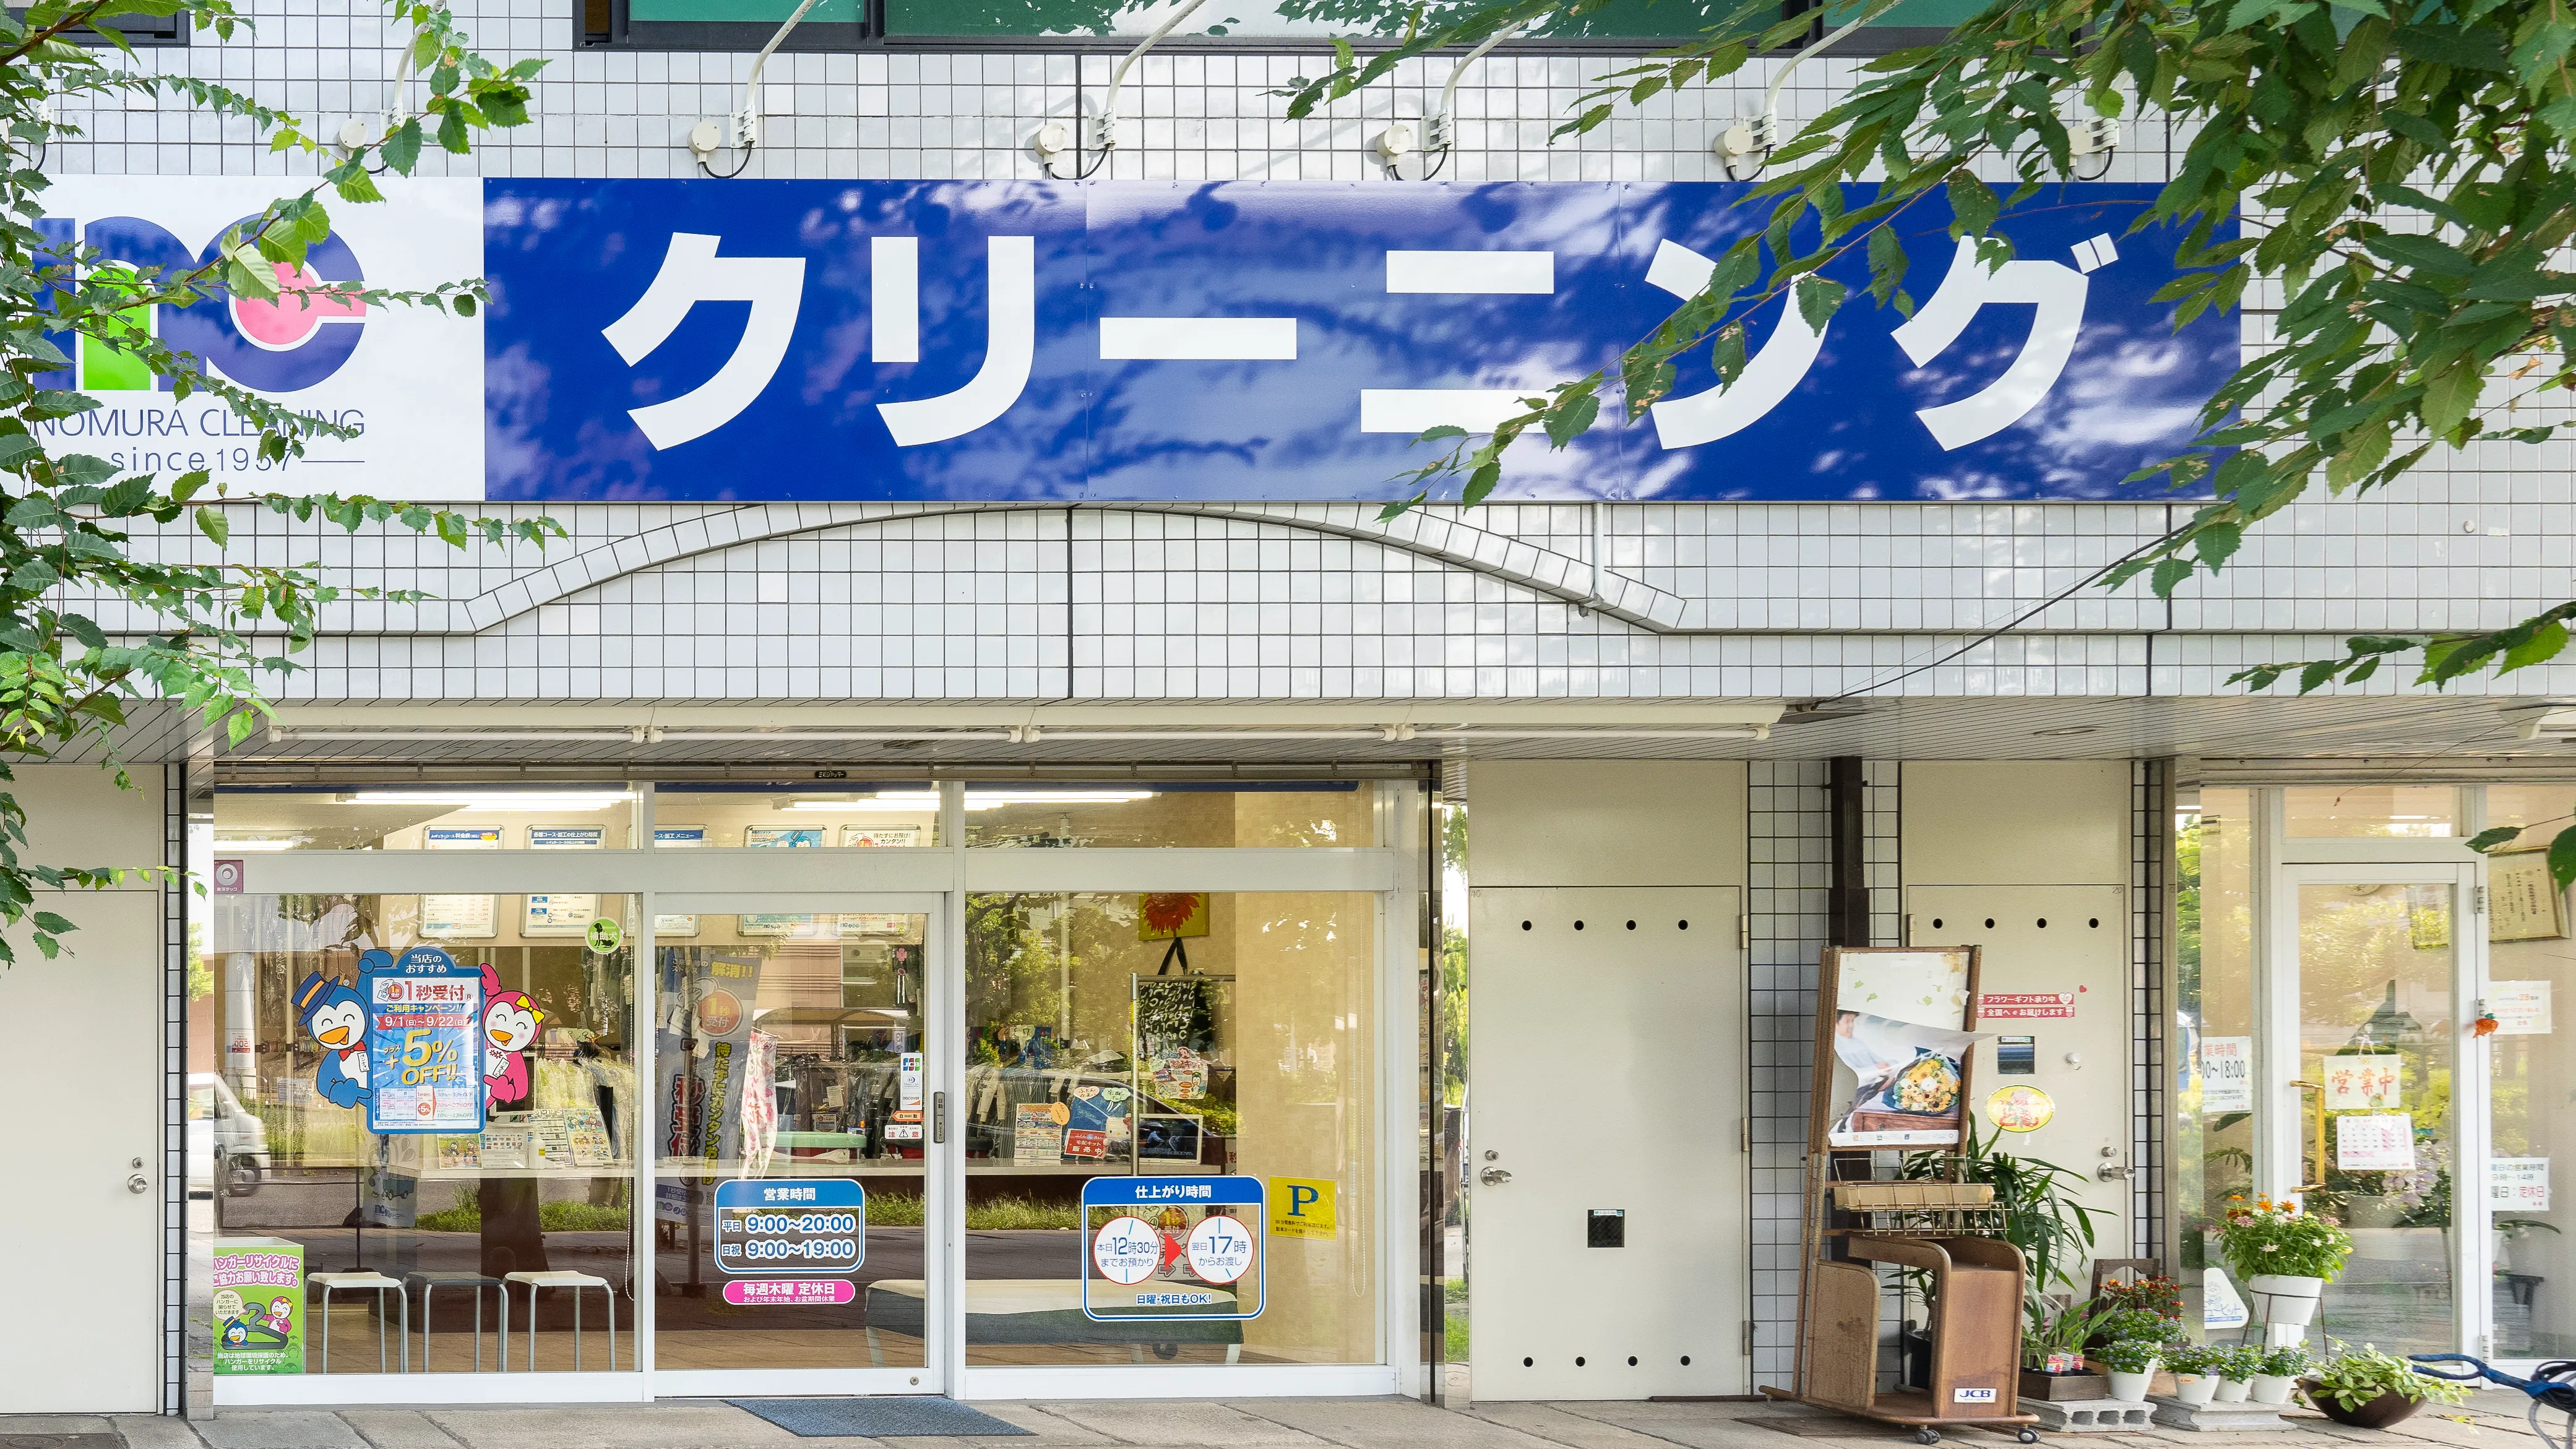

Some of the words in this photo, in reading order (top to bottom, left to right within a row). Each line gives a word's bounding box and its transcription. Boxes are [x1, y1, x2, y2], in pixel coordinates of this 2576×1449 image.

[601, 233, 2118, 451] クリーニング
[33, 409, 189, 436] NOMURA
[200, 409, 364, 436] CLEANING
[111, 447, 205, 471] since
[590, 931, 618, 940] 補助犬
[410, 954, 442, 963] 当店の
[405, 964, 447, 974] おすすめ
[711, 961, 754, 978] 解消!!
[1987, 995, 2056, 1004] フラワーギフト承り中
[386, 1004, 462, 1013] ご利用キャンペーン!!
[1987, 1008, 2011, 1017] 全国へ
[2018, 1008, 2064, 1017] お届けします
[707, 1016, 730, 1028] 受付
[903, 1060, 920, 1068] JCB
[2331, 1067, 2396, 1096] 営業中
[764, 1187, 816, 1202] 営業時間
[1135, 1185, 1212, 1199] 仕上がり時間
[1287, 1185, 1319, 1217] P
[722, 1220, 742, 1232] 平日
[722, 1244, 742, 1256] 日祝
[1097, 1237, 1159, 1255] 本日12時30分
[1192, 1236, 1247, 1254] 翌日17時
[1101, 1257, 1154, 1267] までお預かり
[1198, 1257, 1243, 1266] からお渡し
[213, 1272, 298, 1288] ご協力お願い致します。
[743, 1283, 795, 1296] 毎週木曜
[798, 1283, 835, 1295] 定休日
[1959, 1390, 1991, 1398] JCB
